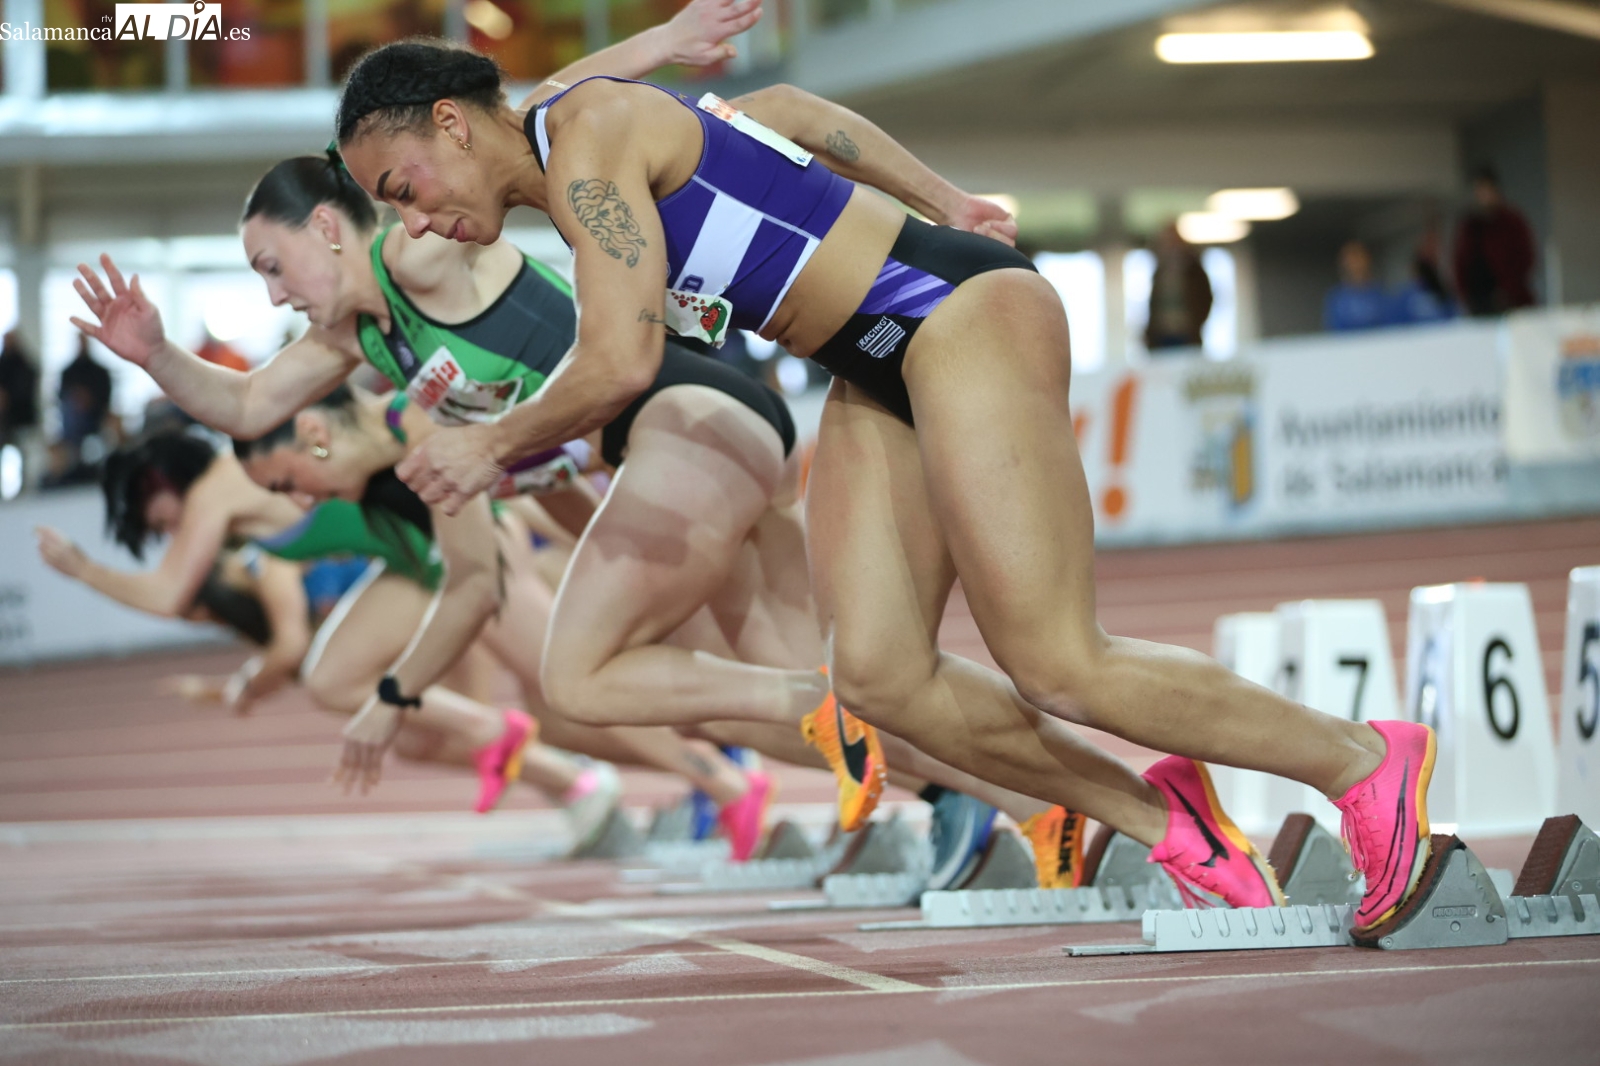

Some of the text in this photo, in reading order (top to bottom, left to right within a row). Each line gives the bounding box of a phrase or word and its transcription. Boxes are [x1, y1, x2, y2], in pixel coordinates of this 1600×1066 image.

[858, 318, 888, 348] RACING
[1337, 656, 1369, 722] 7
[1482, 637, 1521, 741] 6
[1577, 621, 1600, 741] 5
